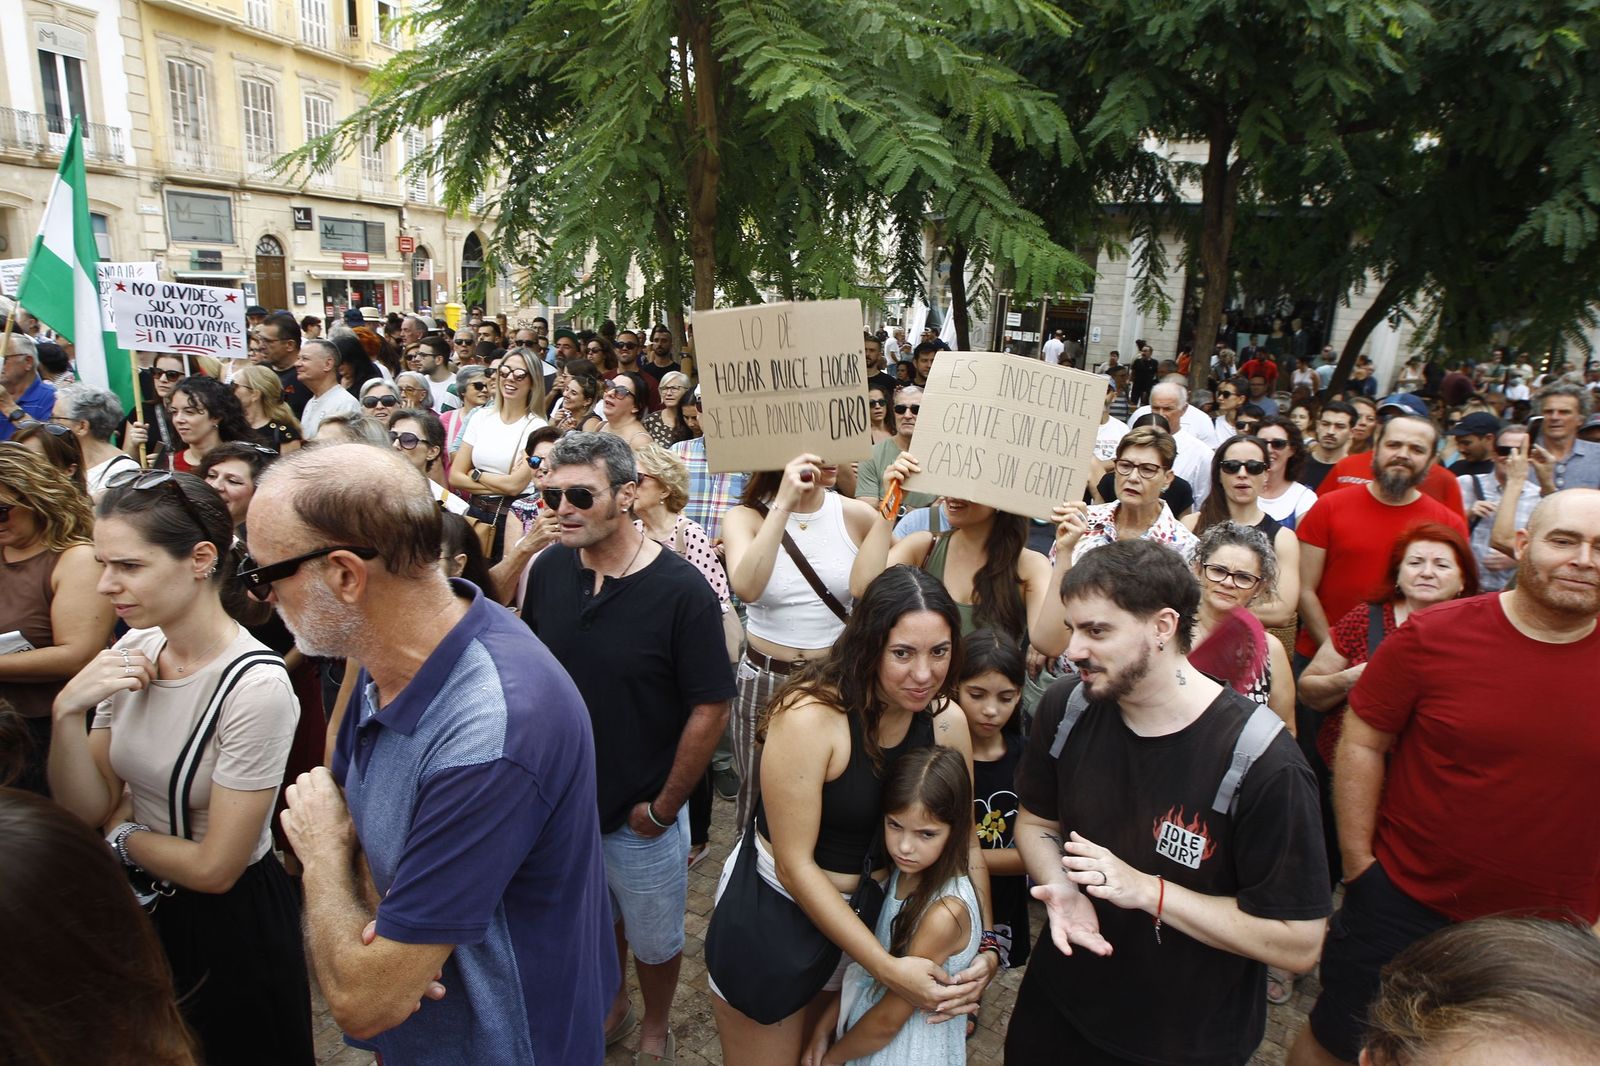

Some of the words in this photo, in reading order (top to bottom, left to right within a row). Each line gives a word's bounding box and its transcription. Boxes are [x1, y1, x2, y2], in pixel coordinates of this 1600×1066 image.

[132, 282, 155, 297] NO
[162, 284, 218, 303] OLVIDES
[147, 300, 175, 314] SUS
[180, 303, 224, 319] VOTOS
[135, 313, 194, 330] CUANDO
[197, 318, 241, 334] VAYAS
[739, 316, 763, 350] LO
[777, 311, 796, 349] DE
[770, 356, 809, 390] DULCE
[949, 358, 979, 392] ES
[707, 406, 725, 439] SE
[765, 399, 826, 435] PONIENDO
[828, 395, 867, 440] CARO
[942, 402, 1005, 440] GENTE
[1005, 412, 1036, 448] SIN
[1038, 419, 1081, 459] CASA
[926, 440, 986, 480] CASAS
[991, 452, 1021, 489] SIN
[1024, 461, 1077, 501] GENTE
[1159, 839, 1199, 864] FURY
[1164, 825, 1200, 850] IDLE
